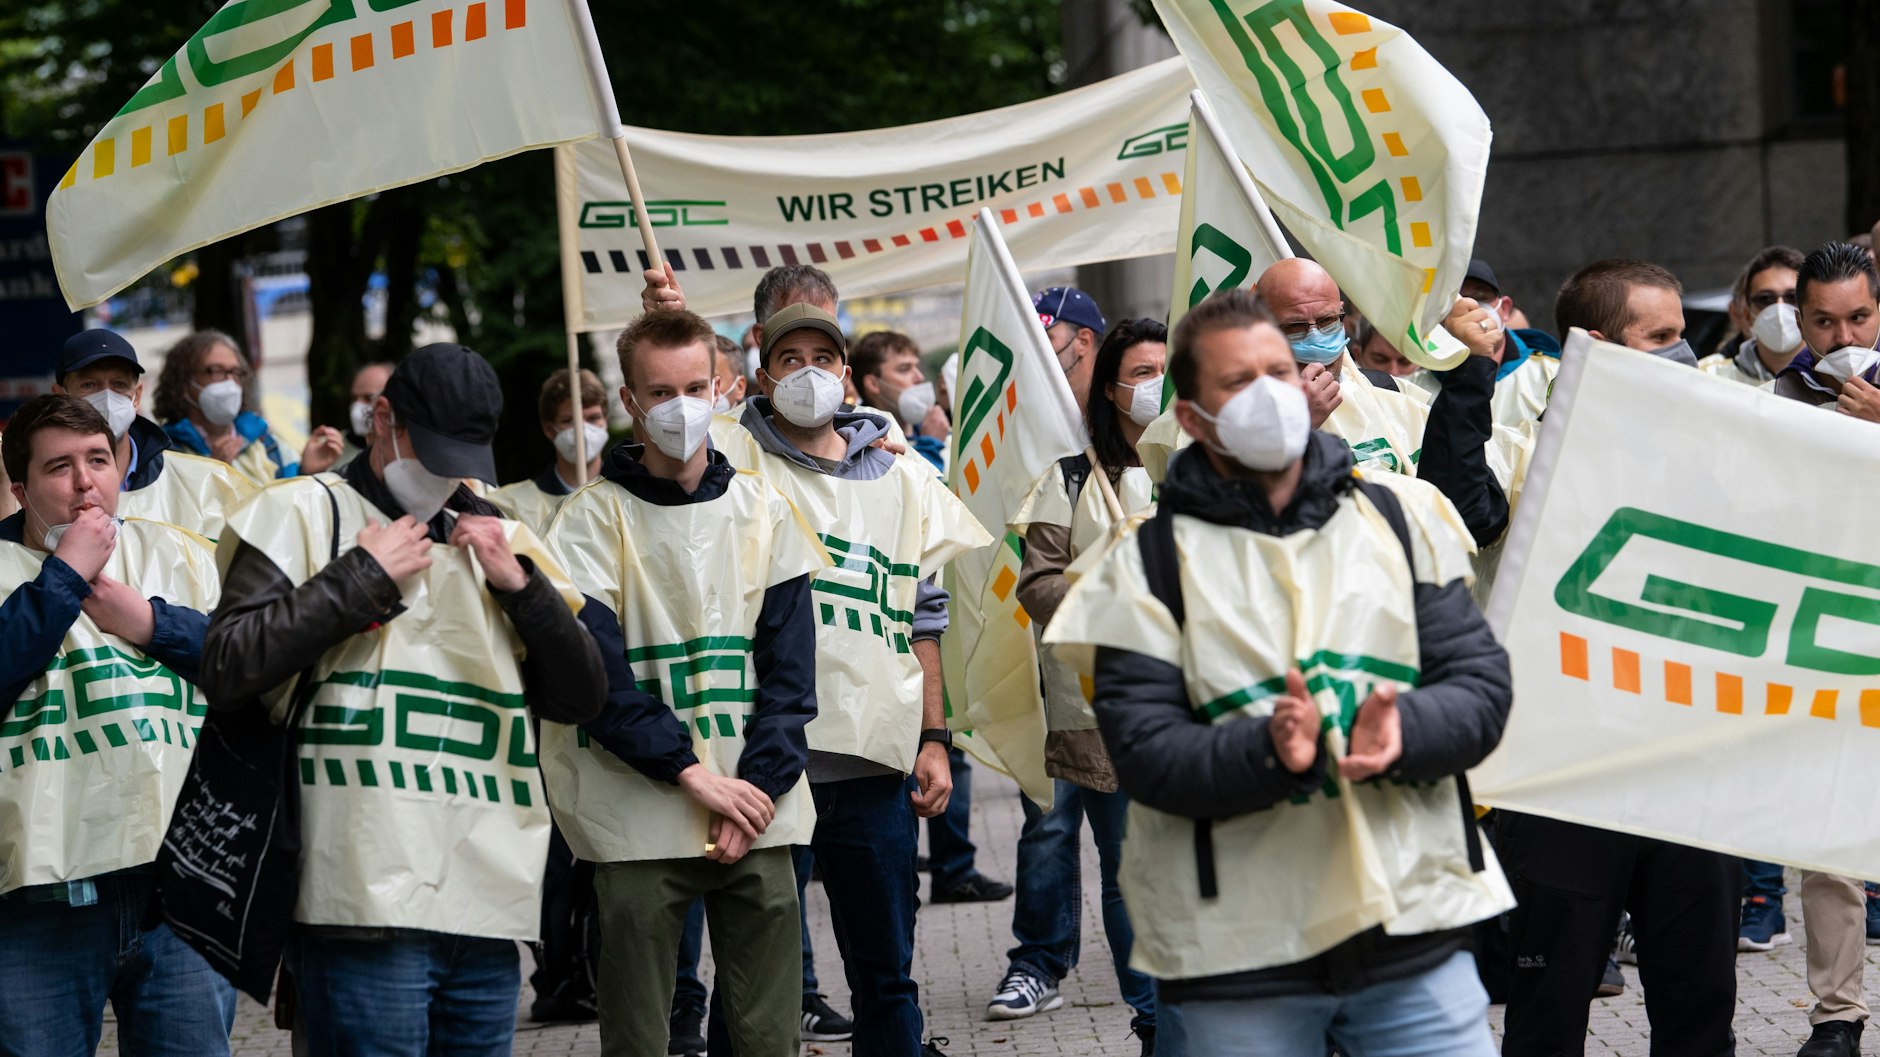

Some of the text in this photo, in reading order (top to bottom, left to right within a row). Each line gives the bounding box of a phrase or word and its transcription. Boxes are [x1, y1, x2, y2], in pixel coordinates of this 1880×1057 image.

[777, 157, 1066, 222] WIR STREIKEN
[578, 200, 729, 228] GDL
